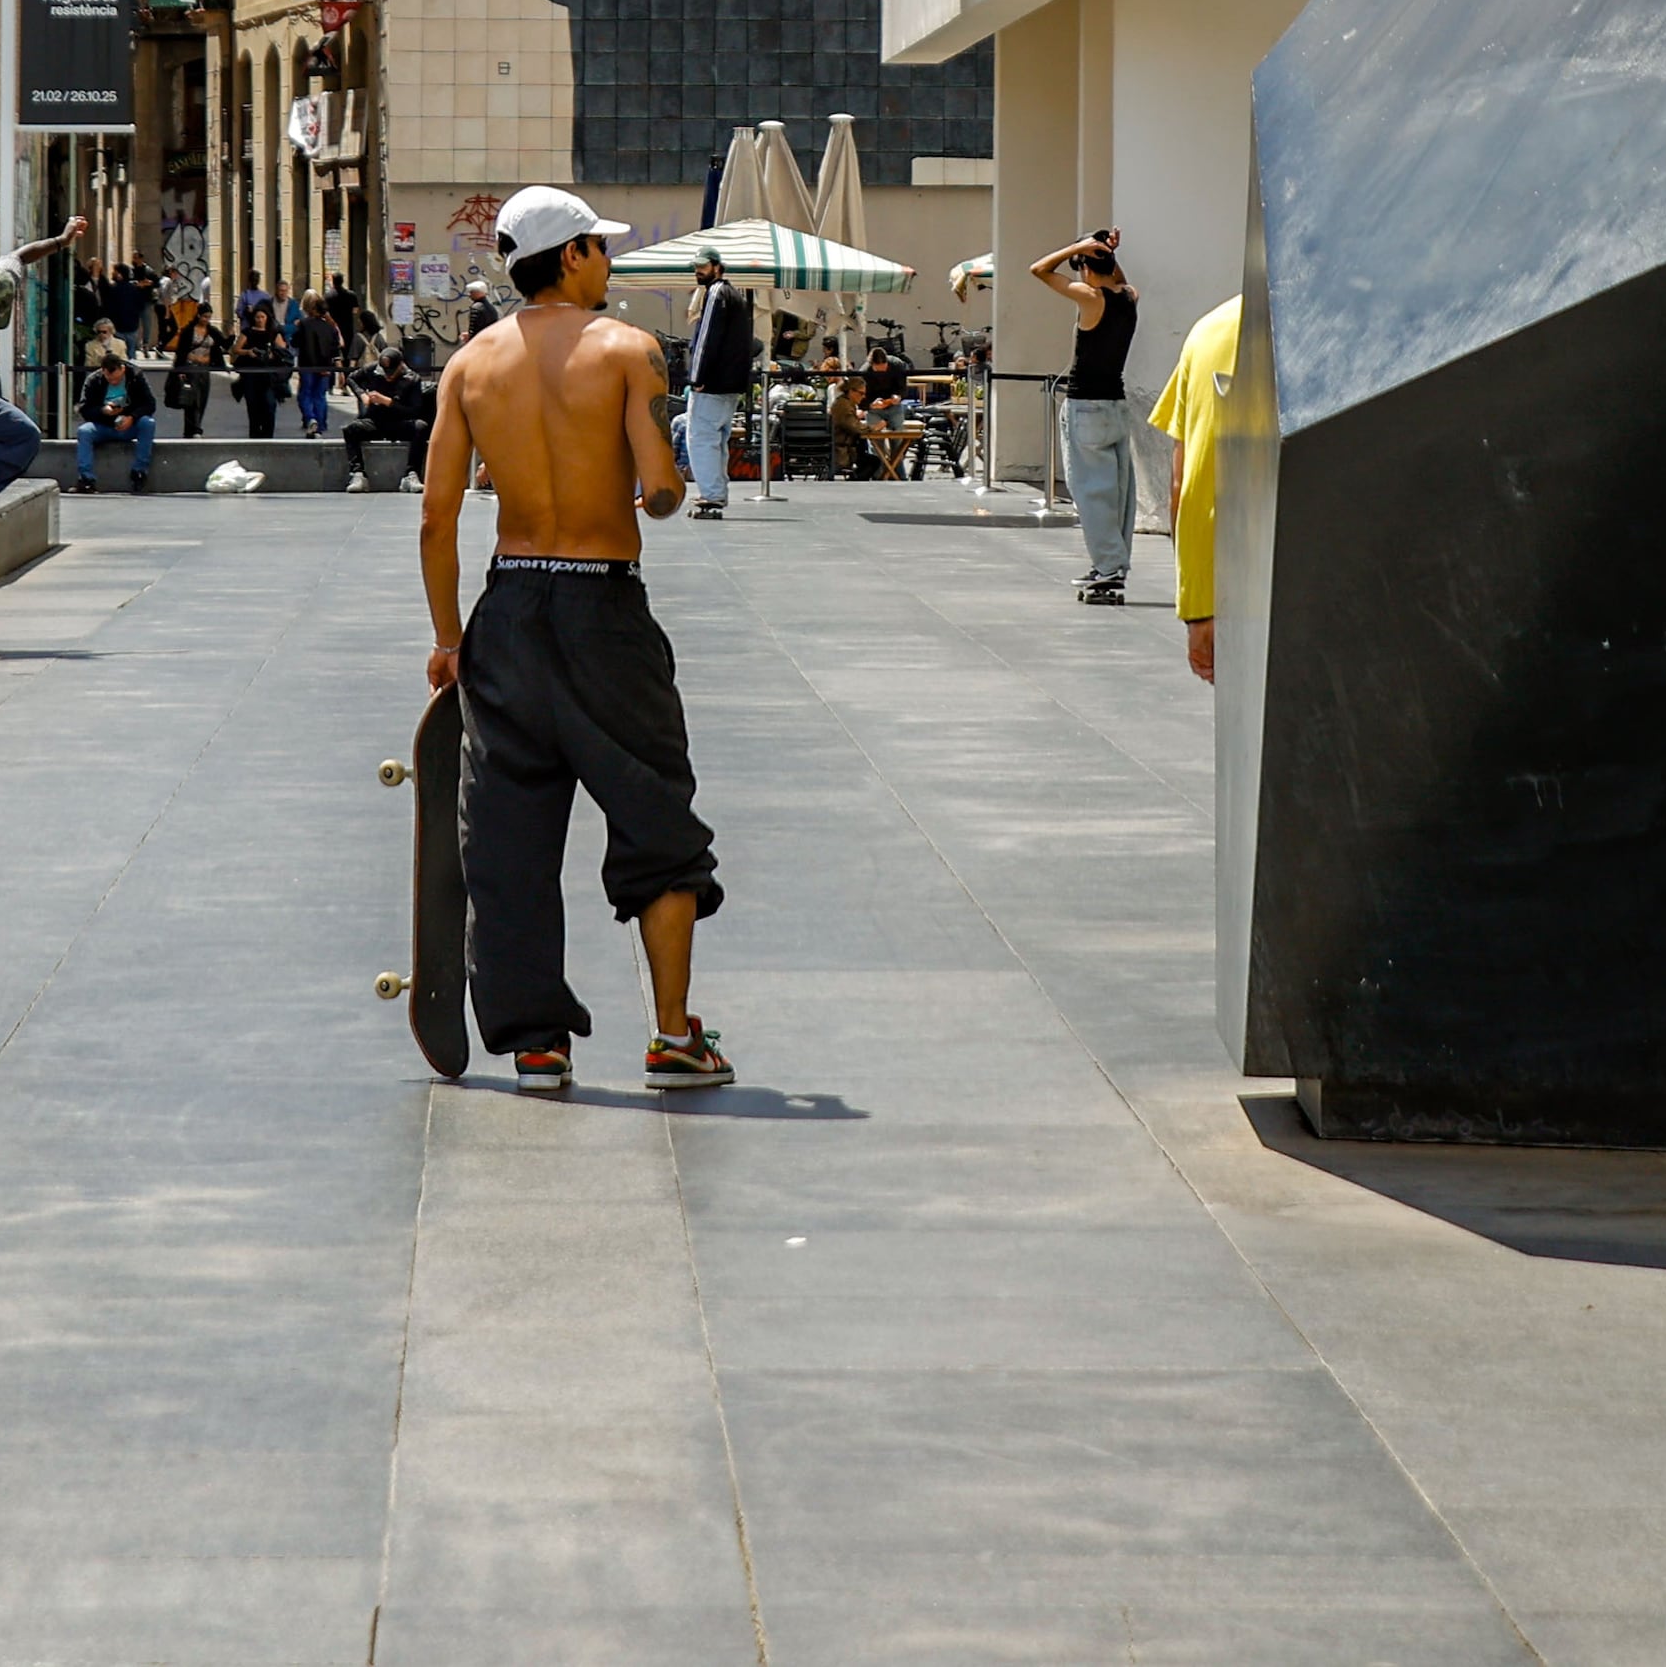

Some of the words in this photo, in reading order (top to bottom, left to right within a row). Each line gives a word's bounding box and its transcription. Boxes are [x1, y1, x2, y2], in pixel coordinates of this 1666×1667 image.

[32, 89, 62, 102] 21.02
[63, 90, 71, 102] /
[70, 89, 118, 103] 26.10.25
